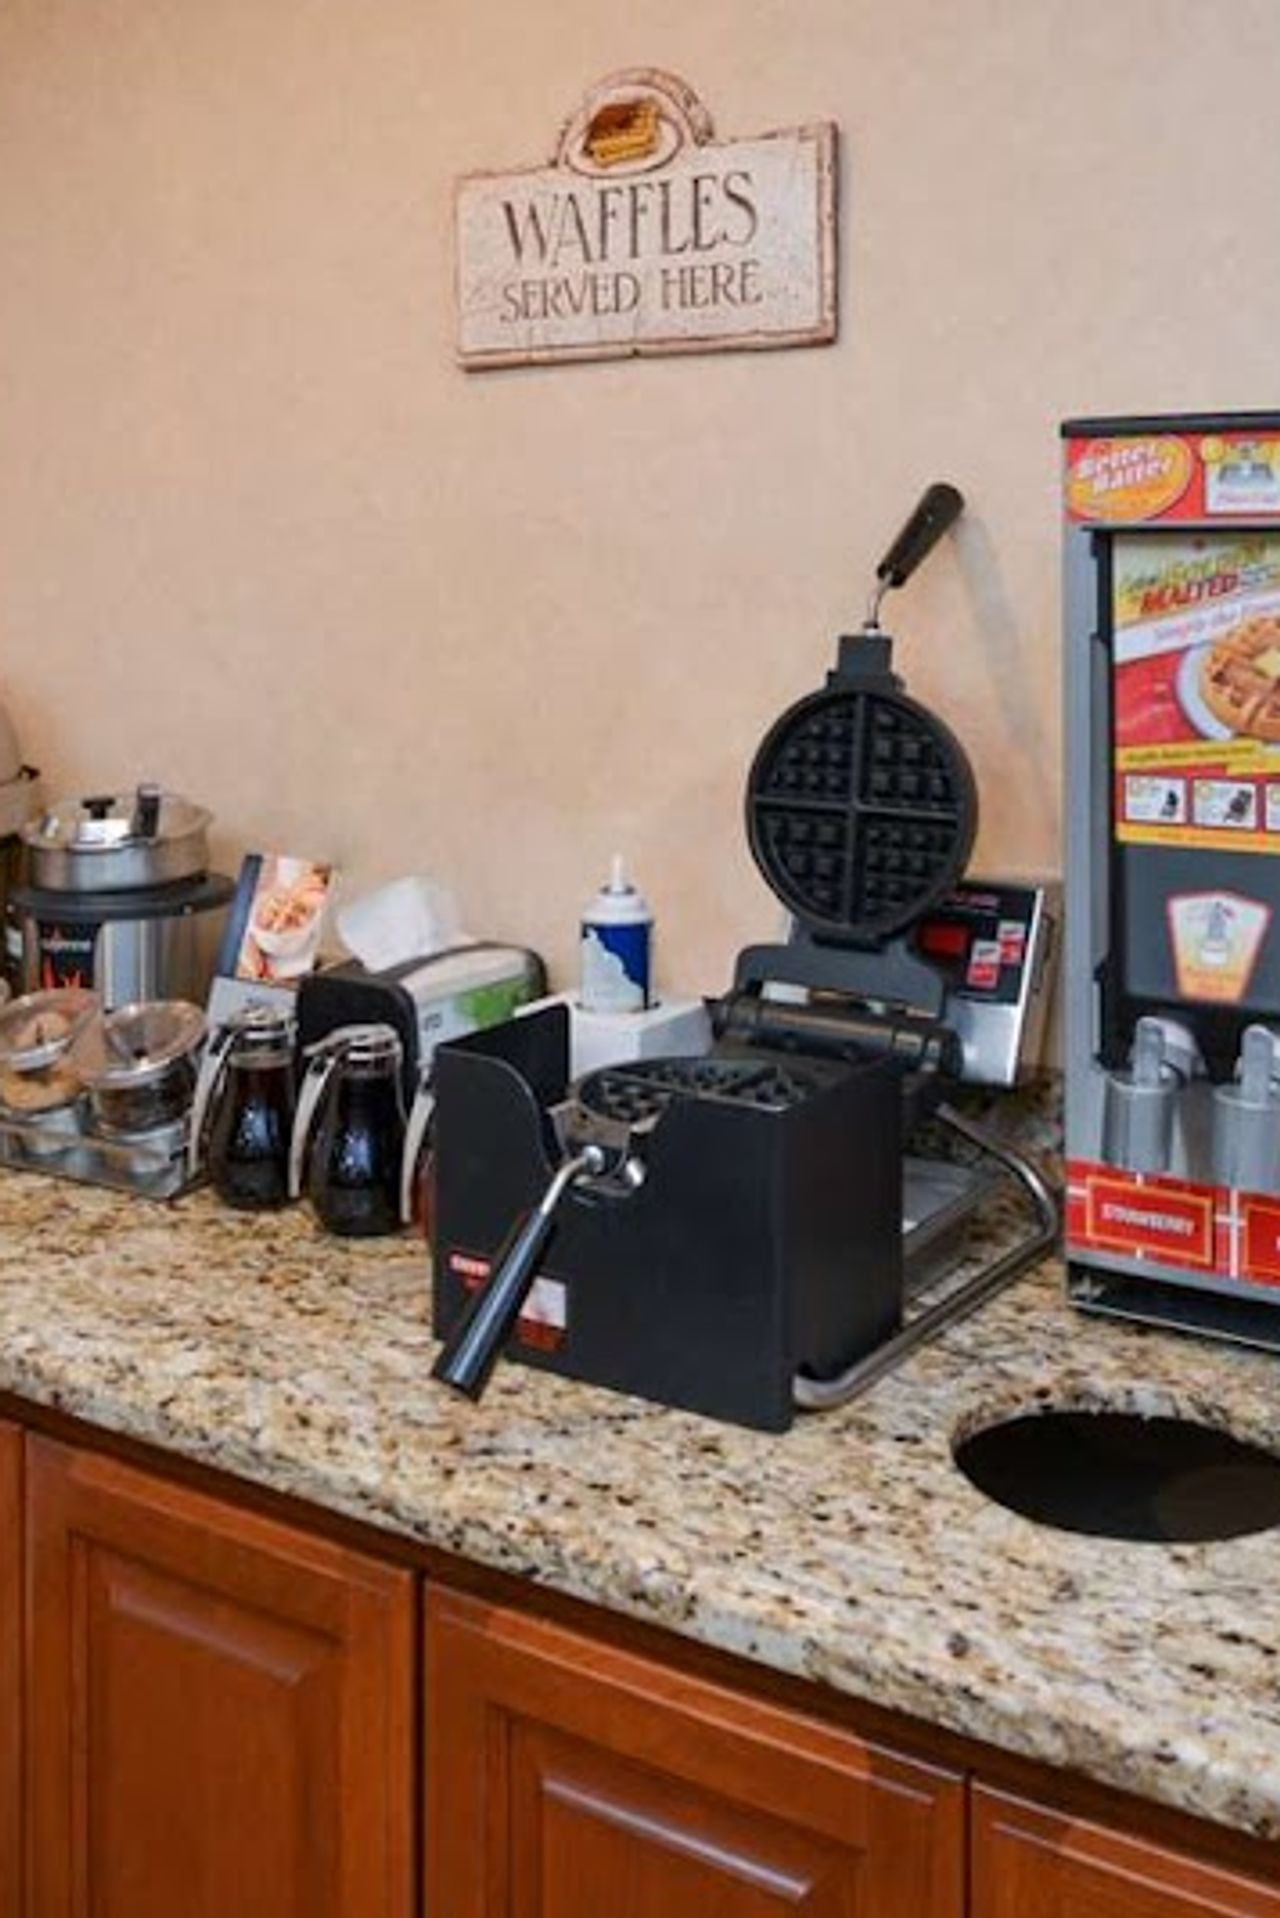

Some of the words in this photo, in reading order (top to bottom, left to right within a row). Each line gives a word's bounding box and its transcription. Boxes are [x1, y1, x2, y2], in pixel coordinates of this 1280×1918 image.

[502, 172, 758, 266] WAFFLES
[500, 273, 641, 322] SERVED
[661, 260, 763, 310] HERE
